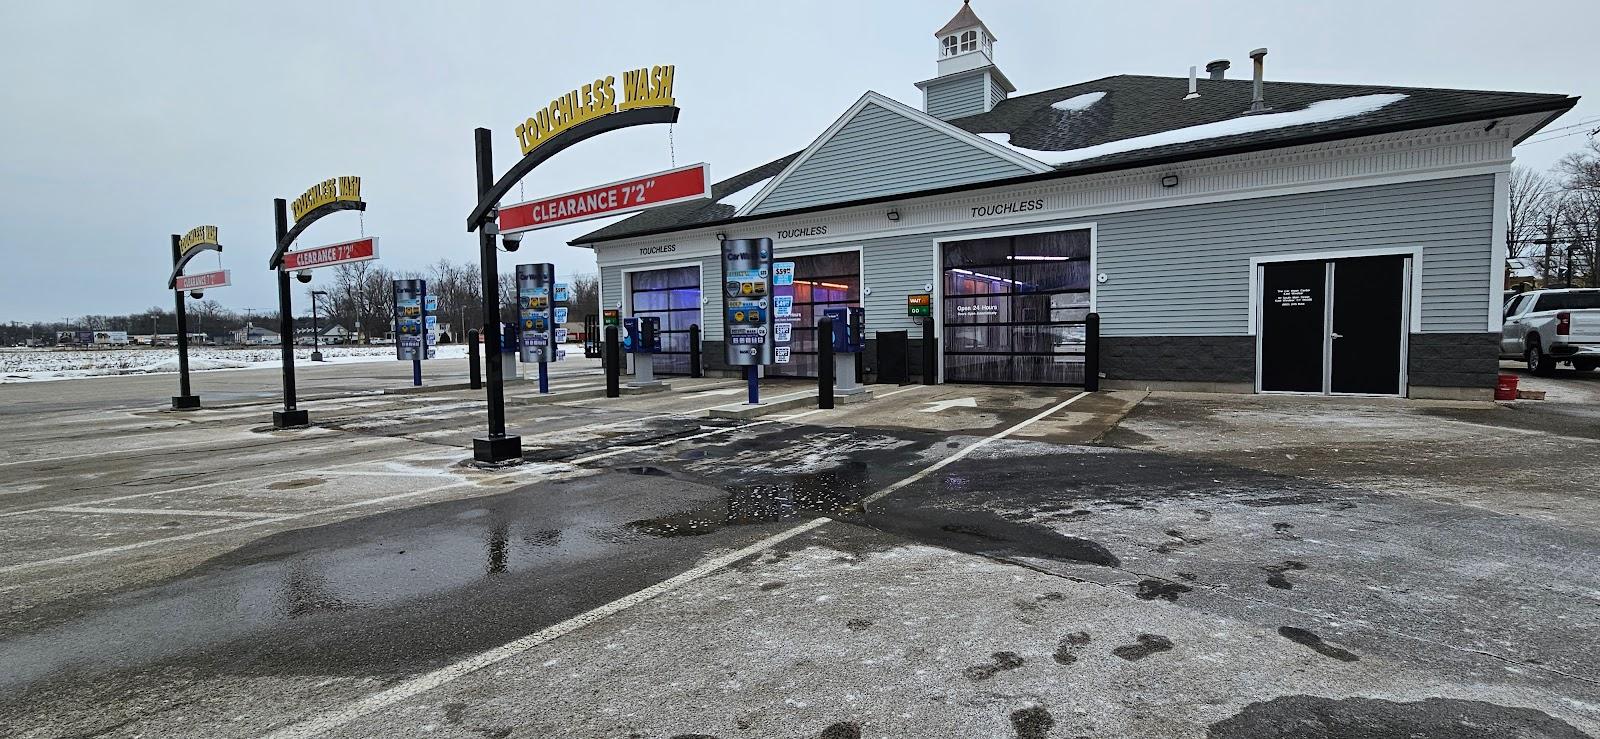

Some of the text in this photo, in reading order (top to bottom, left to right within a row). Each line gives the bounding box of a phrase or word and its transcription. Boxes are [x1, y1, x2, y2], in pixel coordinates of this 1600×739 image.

[515, 65, 675, 156] TOUCHLESS WASH
[291, 176, 361, 223] TOUCHLESS WASH
[532, 190, 617, 222] CLEARANCE
[971, 199, 1044, 218] TOUCHLESS
[777, 226, 828, 240] TOUCHLESS
[296, 248, 336, 266] CLEARANCE
[639, 244, 676, 256] TOUCHLESS
